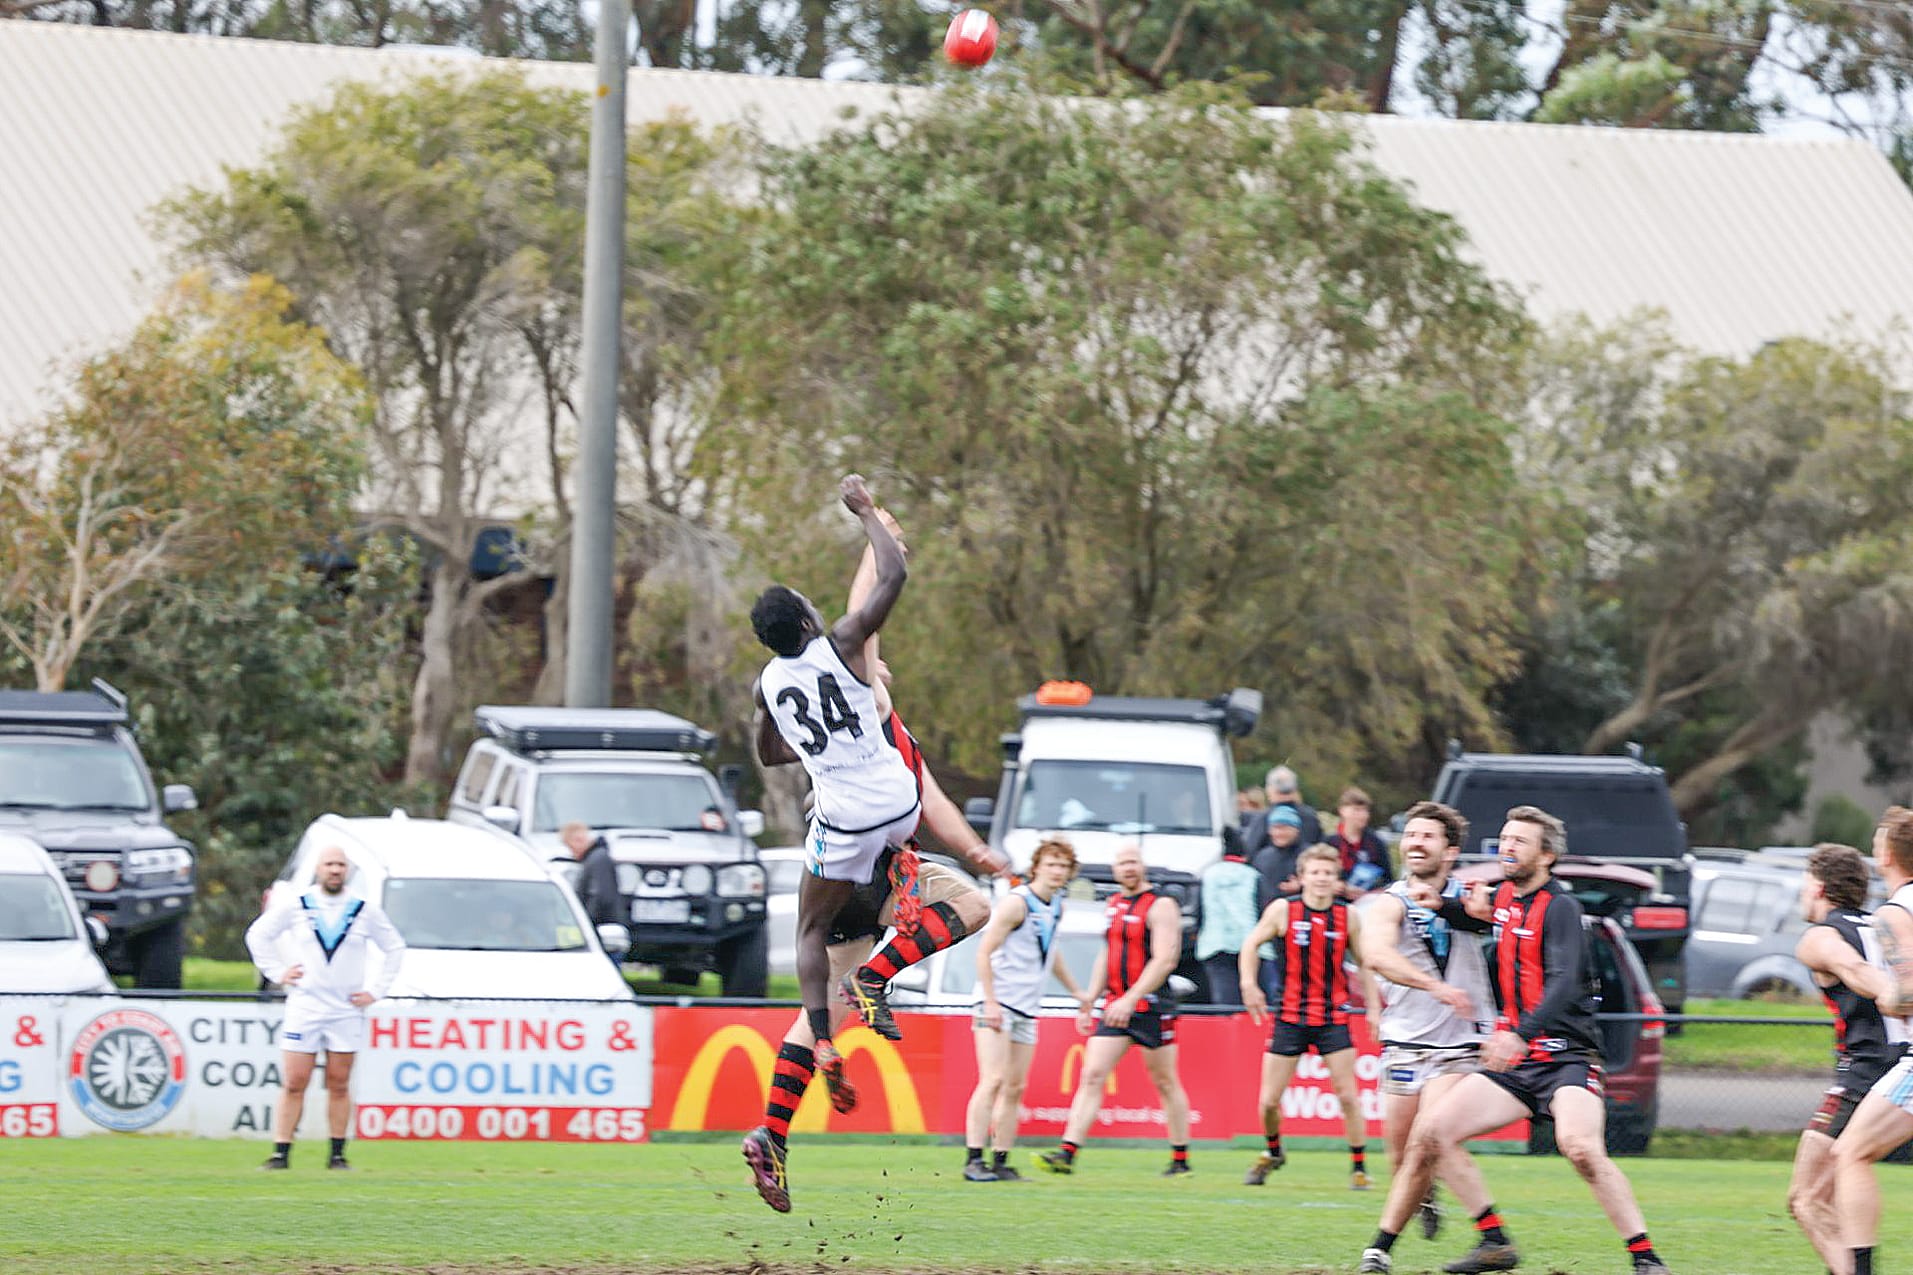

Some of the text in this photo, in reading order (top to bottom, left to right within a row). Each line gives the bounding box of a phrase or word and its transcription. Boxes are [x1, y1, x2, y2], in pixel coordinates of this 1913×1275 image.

[776, 672, 864, 756] 34
[14, 1015, 45, 1047] &
[190, 1018, 283, 1045] CITY
[370, 1018, 637, 1051] HEATING &
[393, 1061, 615, 1095] COOLING
[232, 1105, 299, 1132] AI
[359, 1107, 645, 1141] 0400 001 465
